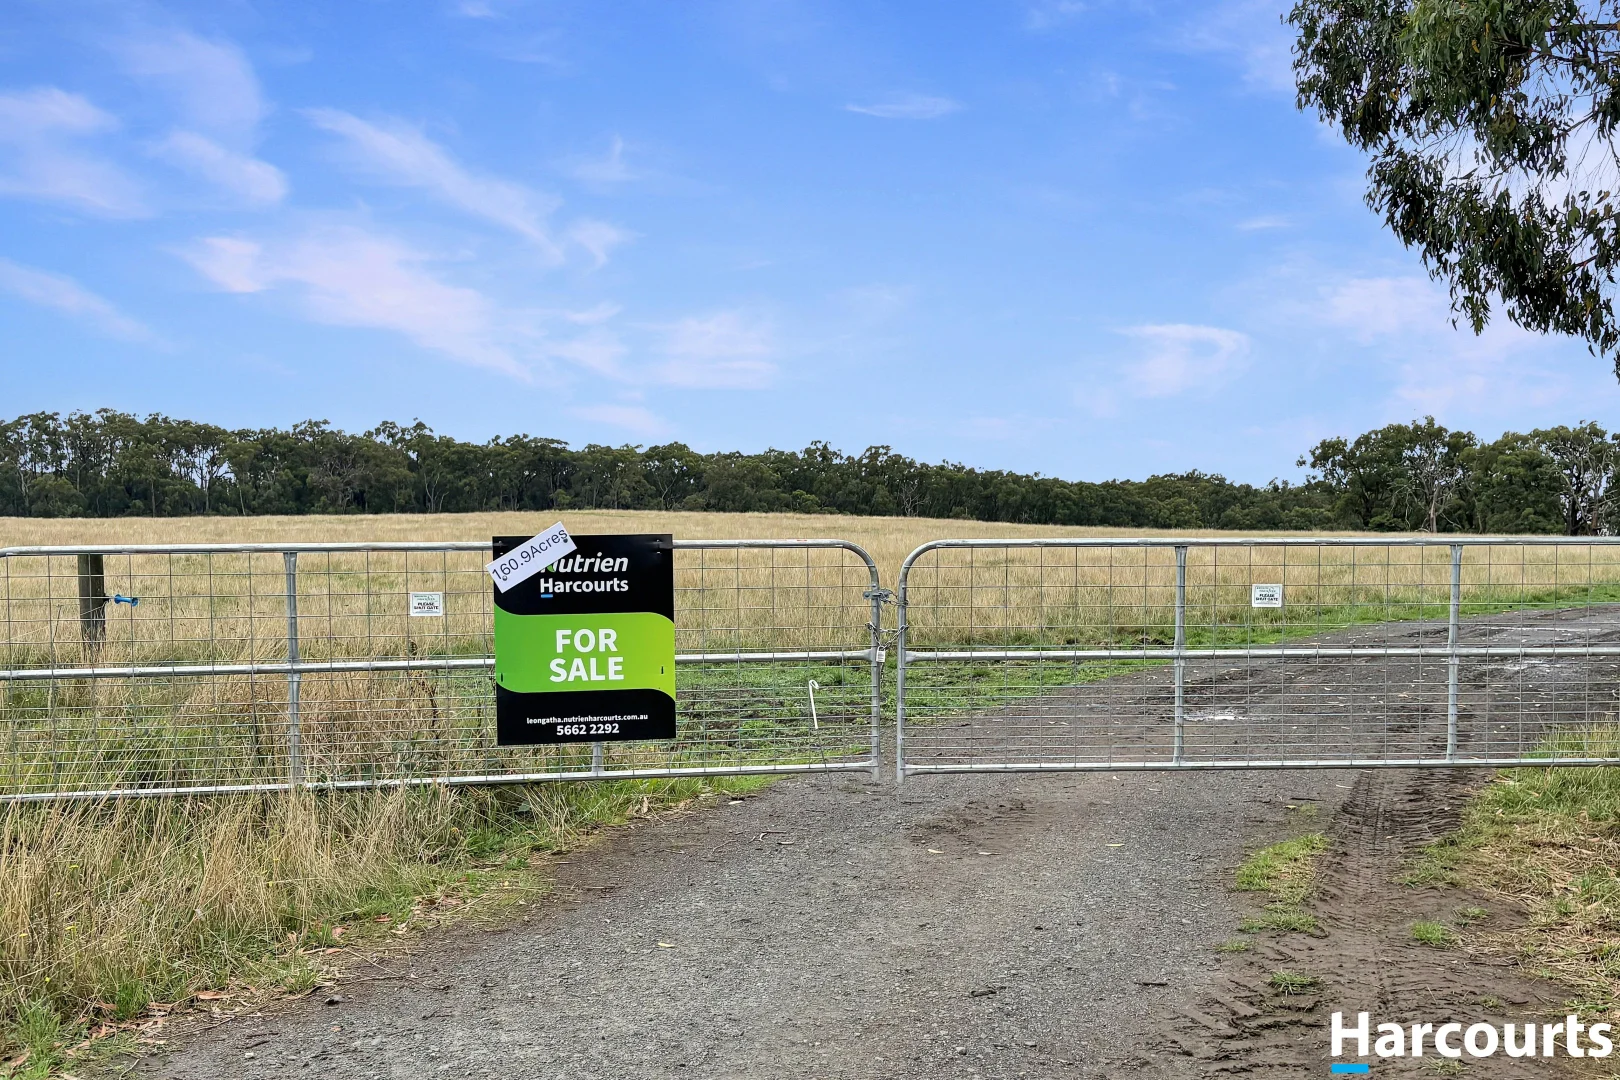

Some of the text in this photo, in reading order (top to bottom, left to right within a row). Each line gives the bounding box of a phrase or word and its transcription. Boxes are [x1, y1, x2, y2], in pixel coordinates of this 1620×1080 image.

[492, 529, 568, 580] 160.9Acres
[540, 577, 629, 593] Harcourts
[555, 628, 618, 653] FOR
[549, 656, 625, 683] SALE
[526, 714, 648, 725] leongatha.nutrienharcourts.com.au
[556, 723, 620, 735] 5662 2292
